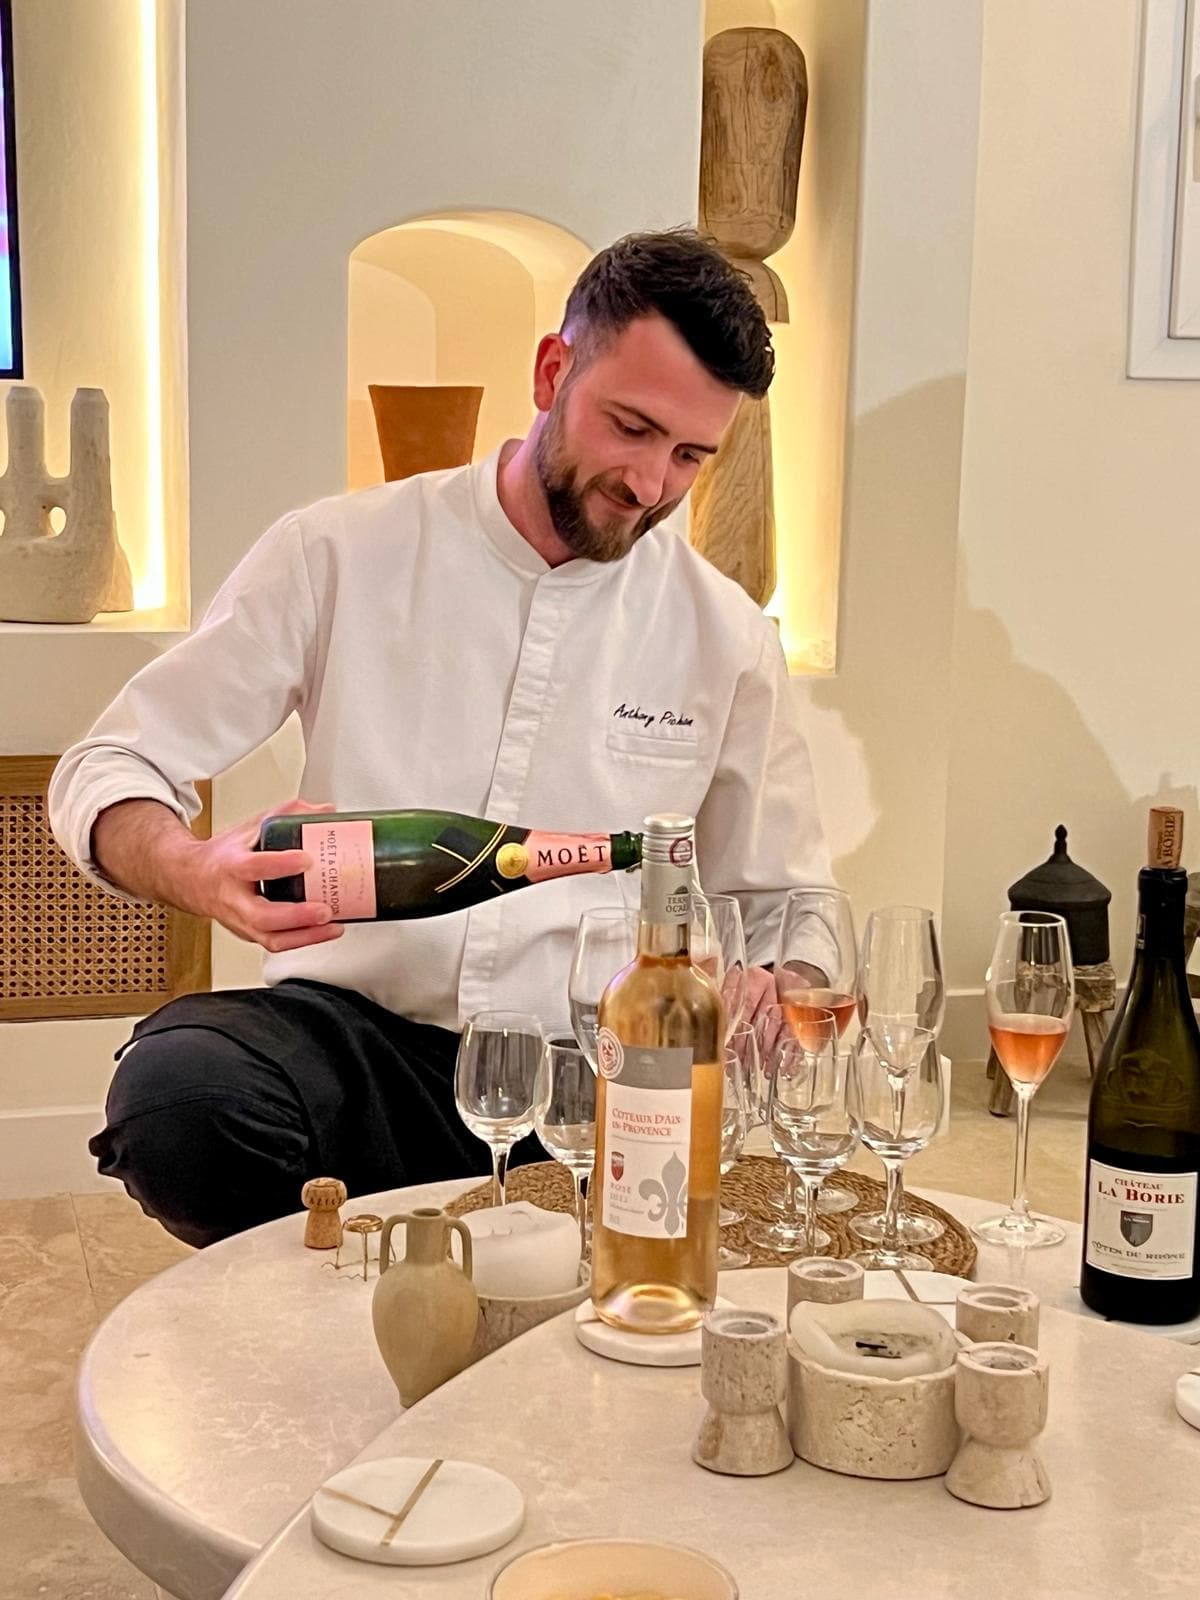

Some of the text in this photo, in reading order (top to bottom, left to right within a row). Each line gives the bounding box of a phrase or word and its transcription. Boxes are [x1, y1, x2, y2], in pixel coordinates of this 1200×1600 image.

[327, 830, 337, 857] MOËT
[537, 844, 608, 867] MOËT
[328, 867, 340, 915] CHANDON
[612, 1107, 653, 1124] COTEAUX
[1098, 1181, 1185, 1204] LA BORIE
[1114, 1178, 1163, 1190] CHÂTEAU
[1092, 1240, 1122, 1254] CÔTES
[1126, 1250, 1141, 1258] DU
[1145, 1252, 1185, 1260] RHÔNE
